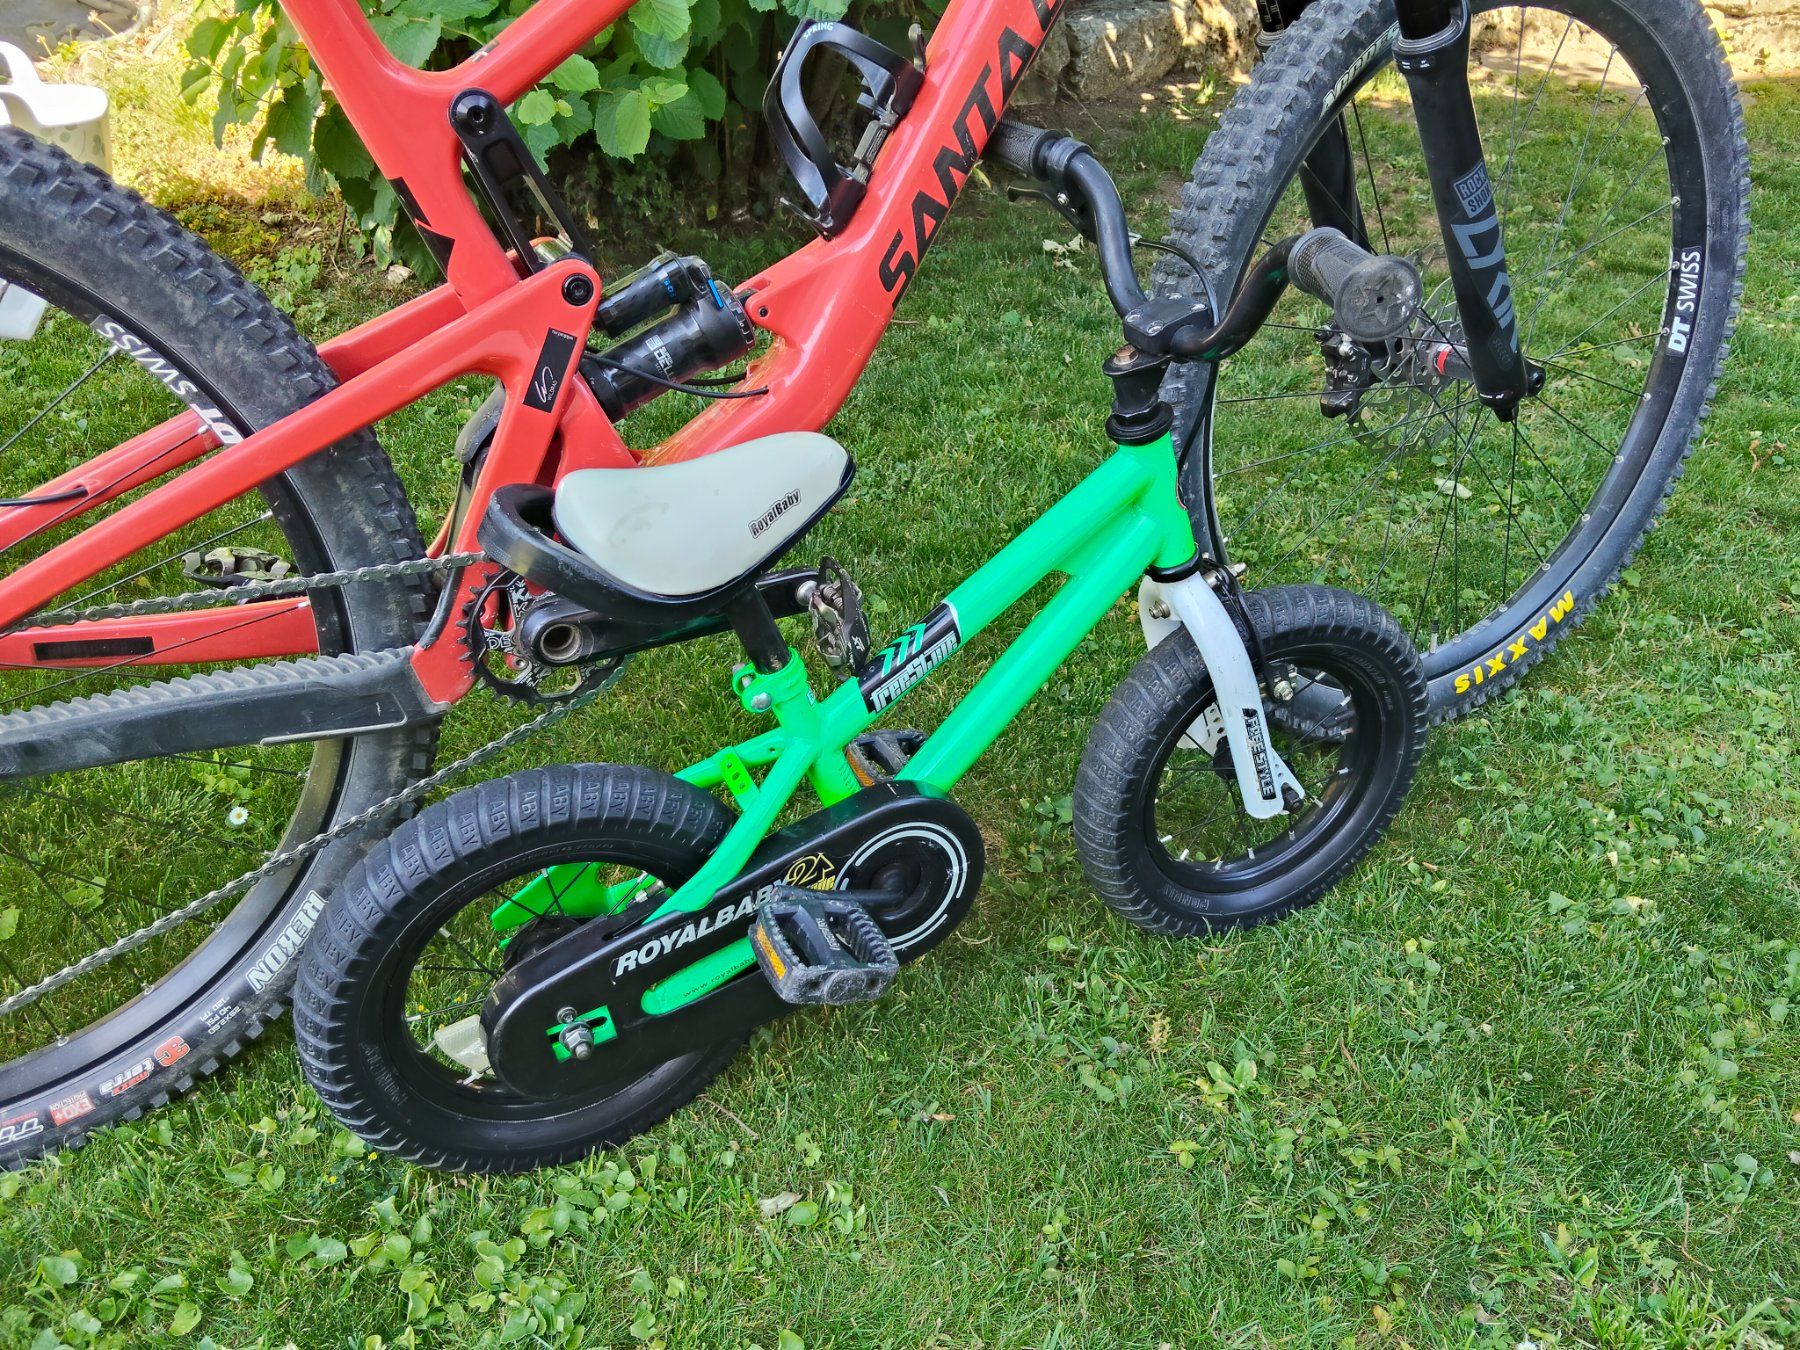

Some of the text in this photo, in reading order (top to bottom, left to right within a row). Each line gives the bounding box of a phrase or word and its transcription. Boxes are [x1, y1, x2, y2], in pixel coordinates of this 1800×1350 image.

[803, 22, 834, 39] SPRING
[878, 26, 1036, 310] SANTA
[1468, 183, 1492, 212] SHO
[1668, 251, 1701, 352] DT SWISS
[96, 322, 244, 443] DT SWISS
[750, 490, 800, 536] RoyalBaby
[1454, 590, 1575, 694] MAXXIS
[246, 890, 327, 994] REKON
